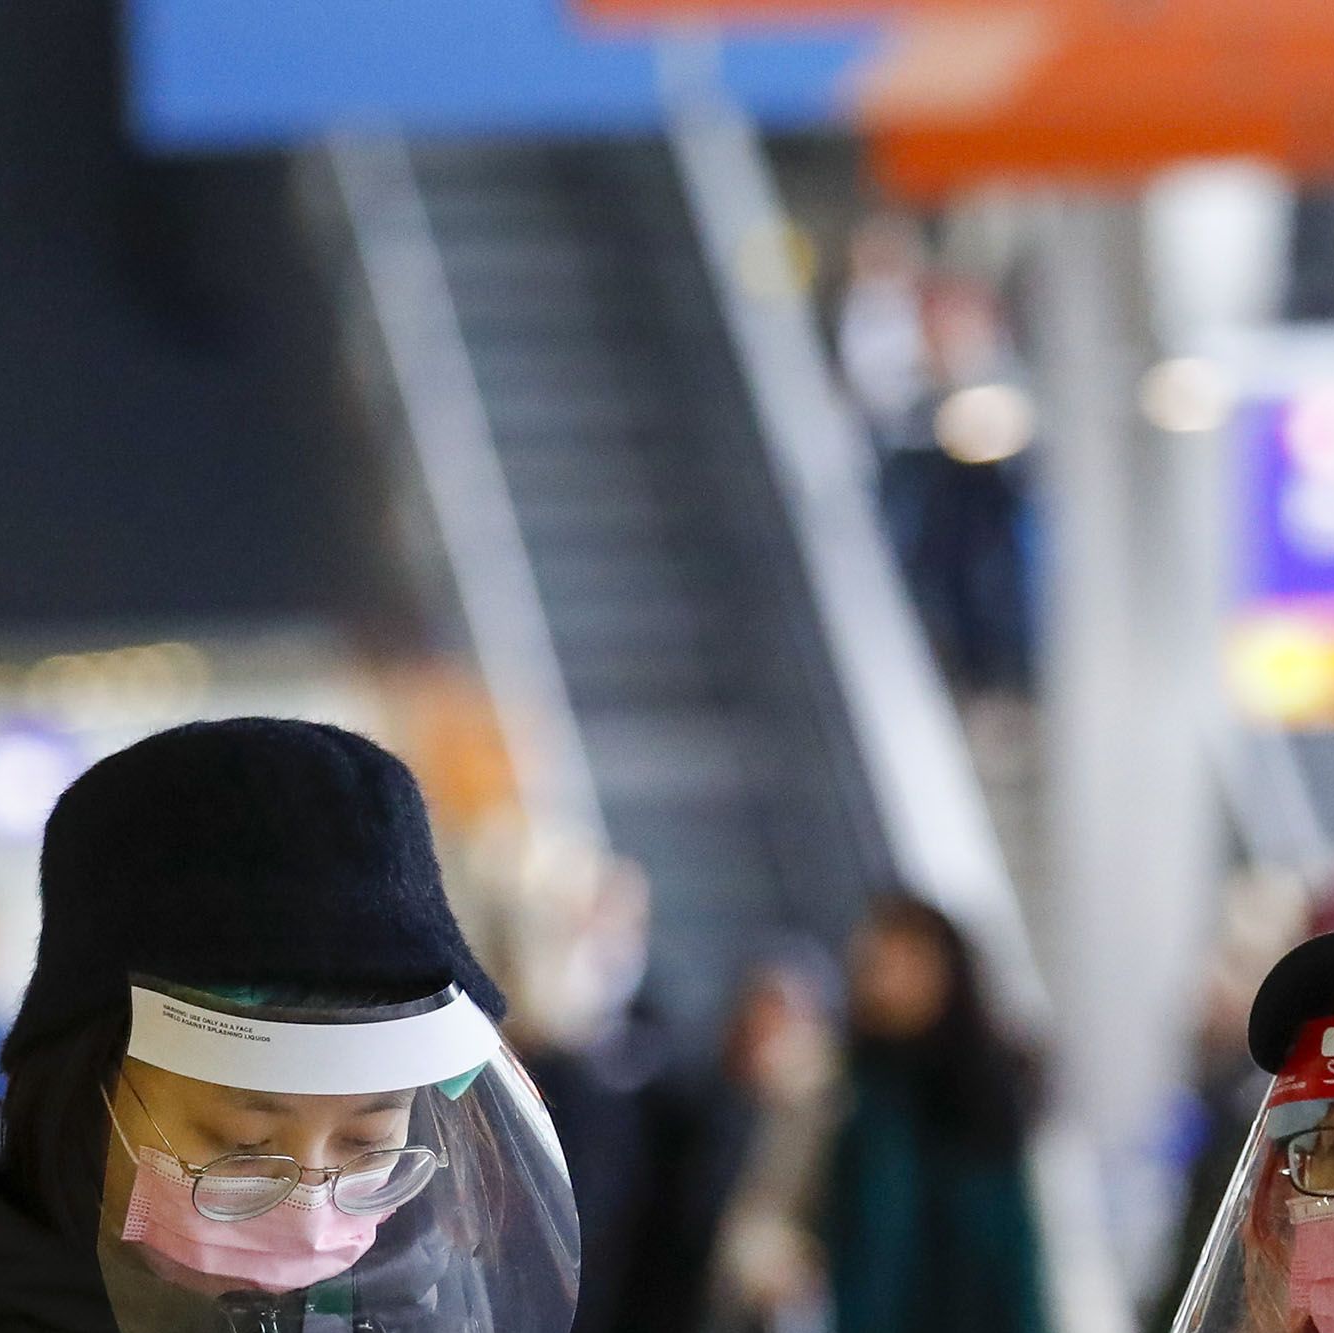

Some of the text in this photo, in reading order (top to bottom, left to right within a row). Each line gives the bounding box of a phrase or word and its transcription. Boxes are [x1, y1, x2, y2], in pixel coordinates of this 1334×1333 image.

[181, 1018, 206, 1030] AGAINST
[207, 1026, 243, 1039] SPLASHING
[190, 1014, 201, 1022] USE
[202, 1017, 218, 1026] ONLY
[235, 1024, 253, 1033] FACE
